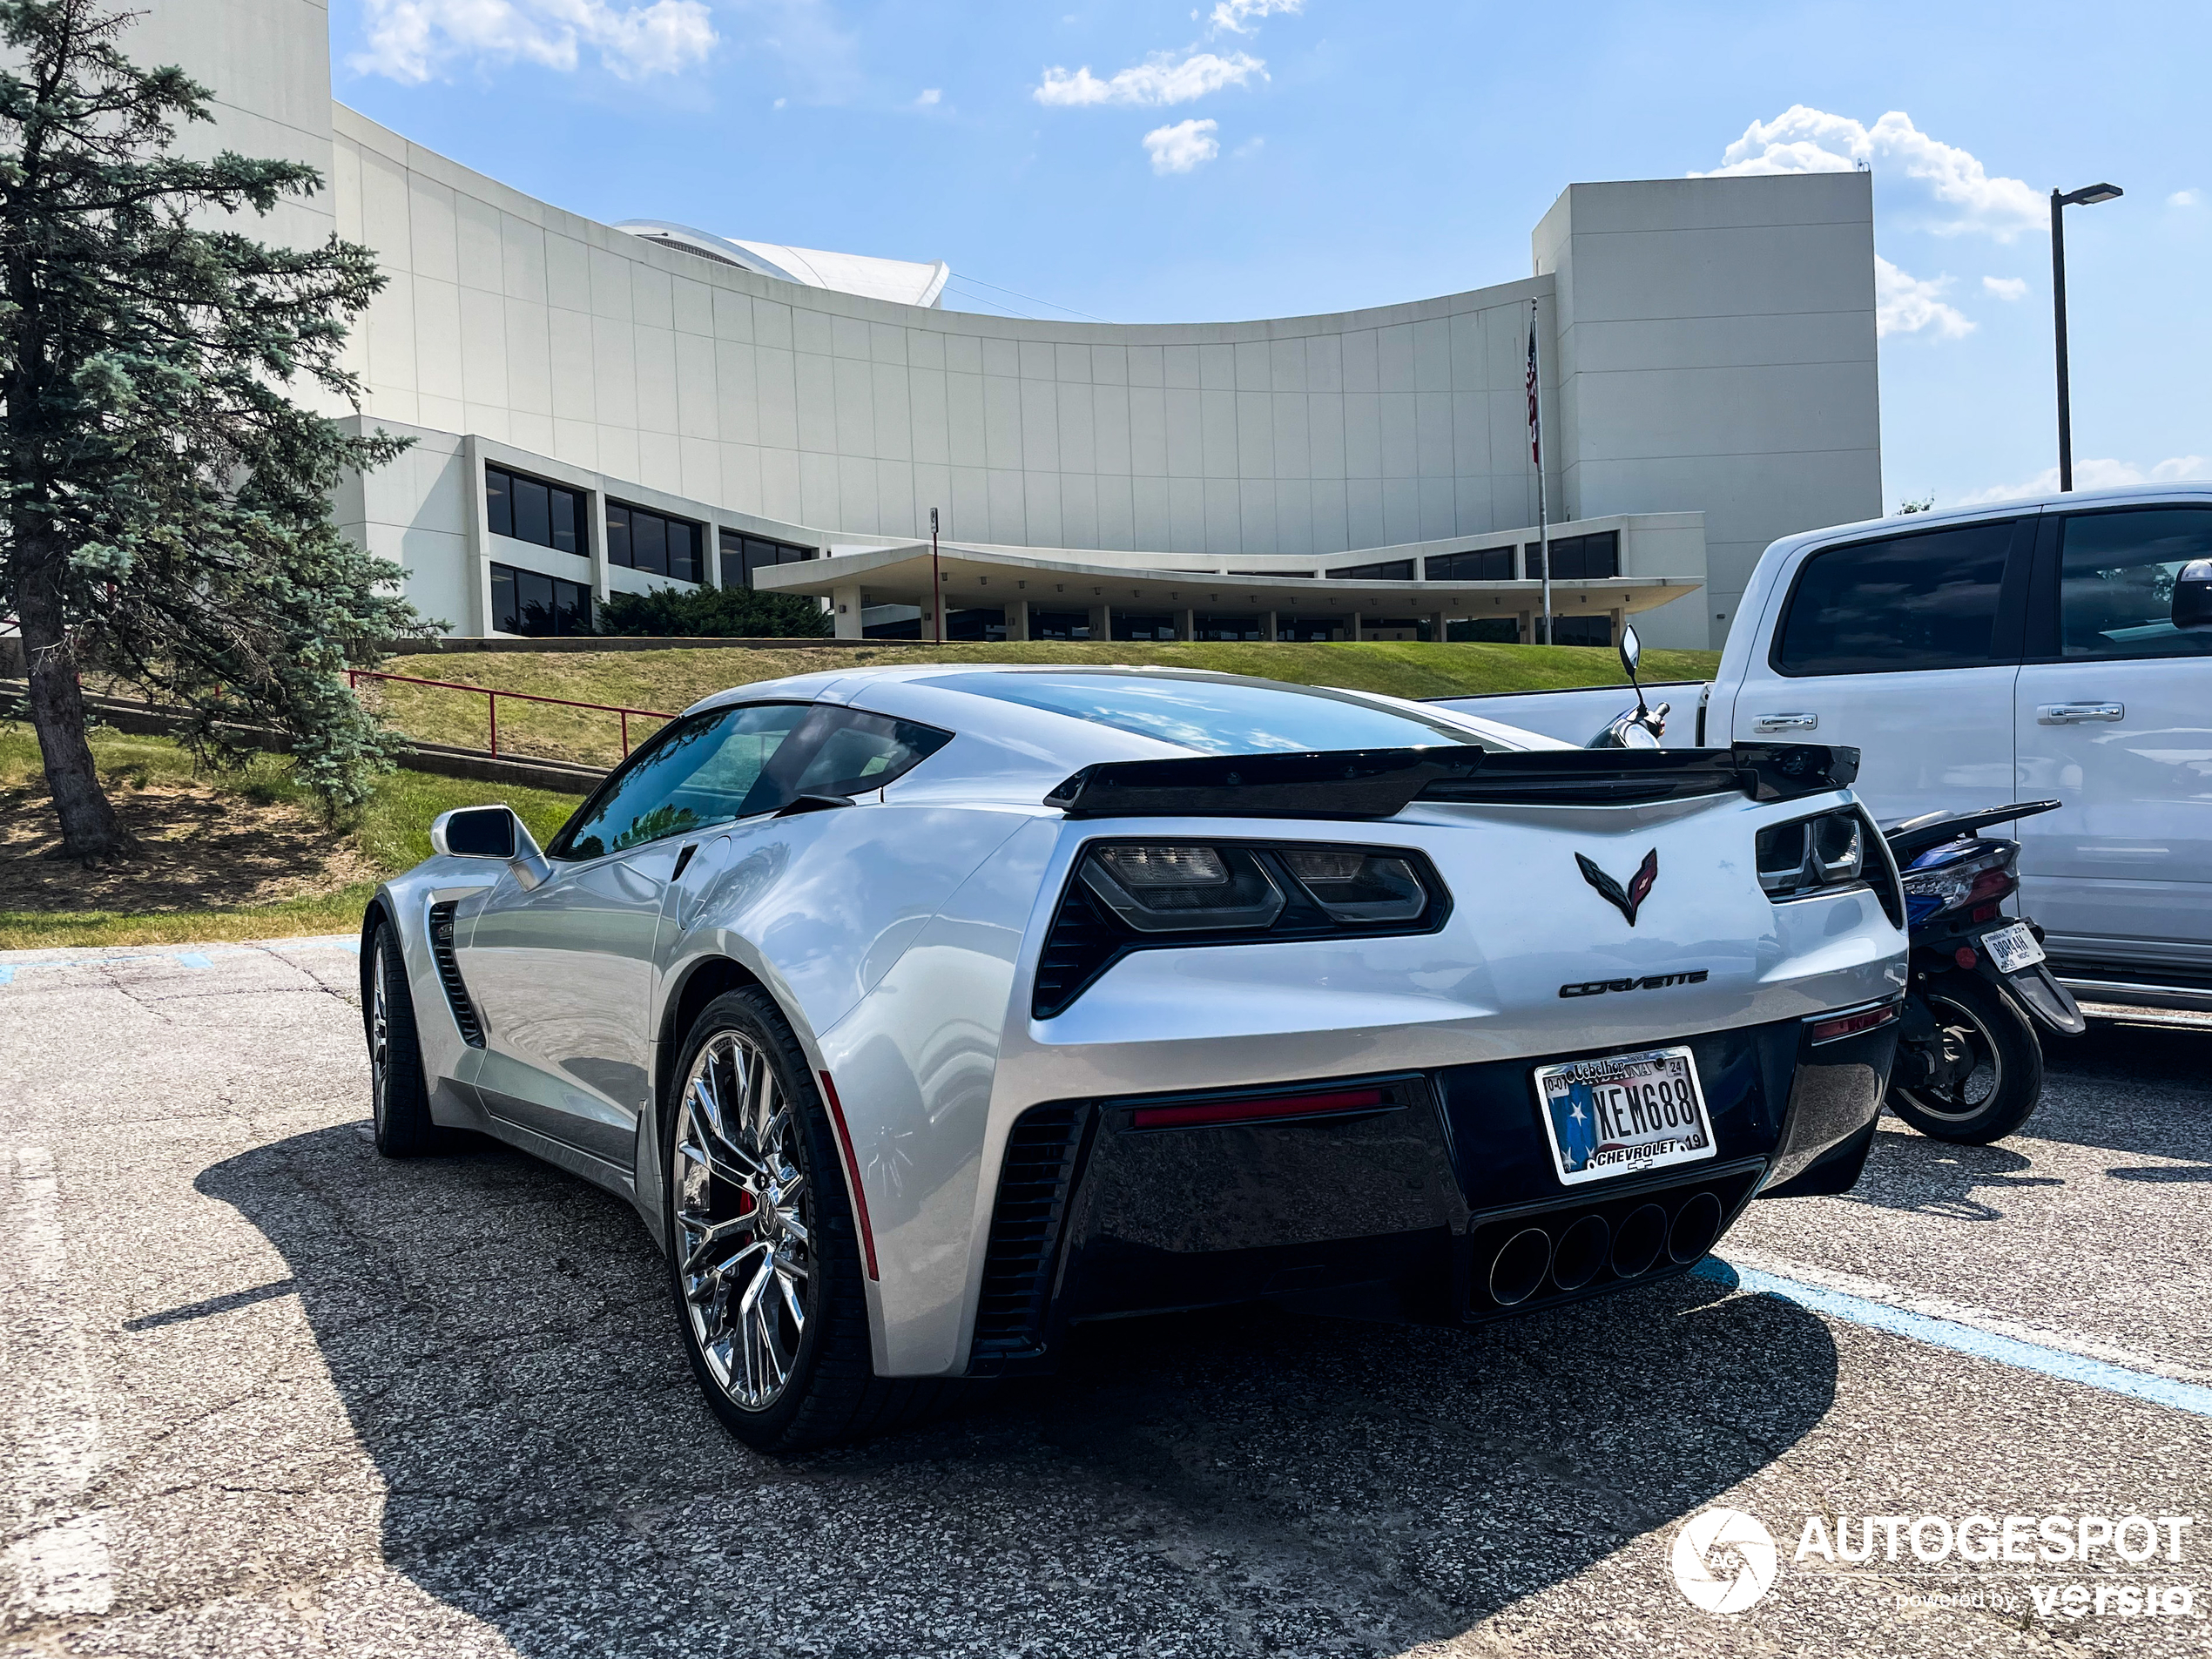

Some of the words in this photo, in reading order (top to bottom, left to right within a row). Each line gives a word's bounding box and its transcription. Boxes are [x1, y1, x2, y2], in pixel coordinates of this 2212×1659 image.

[1993, 934, 2029, 959] B8944H
[1559, 968, 1709, 999] CORVETTE
[1574, 1060, 1625, 1081] Uebelhor
[1669, 1061, 1682, 1073] 24
[1592, 1078, 1695, 1142] XEM688
[1597, 1140, 1676, 1166] CHEVROLET
[1685, 1134, 1701, 1148] 19
[799, 1144, 818, 1256] MICHELIN
